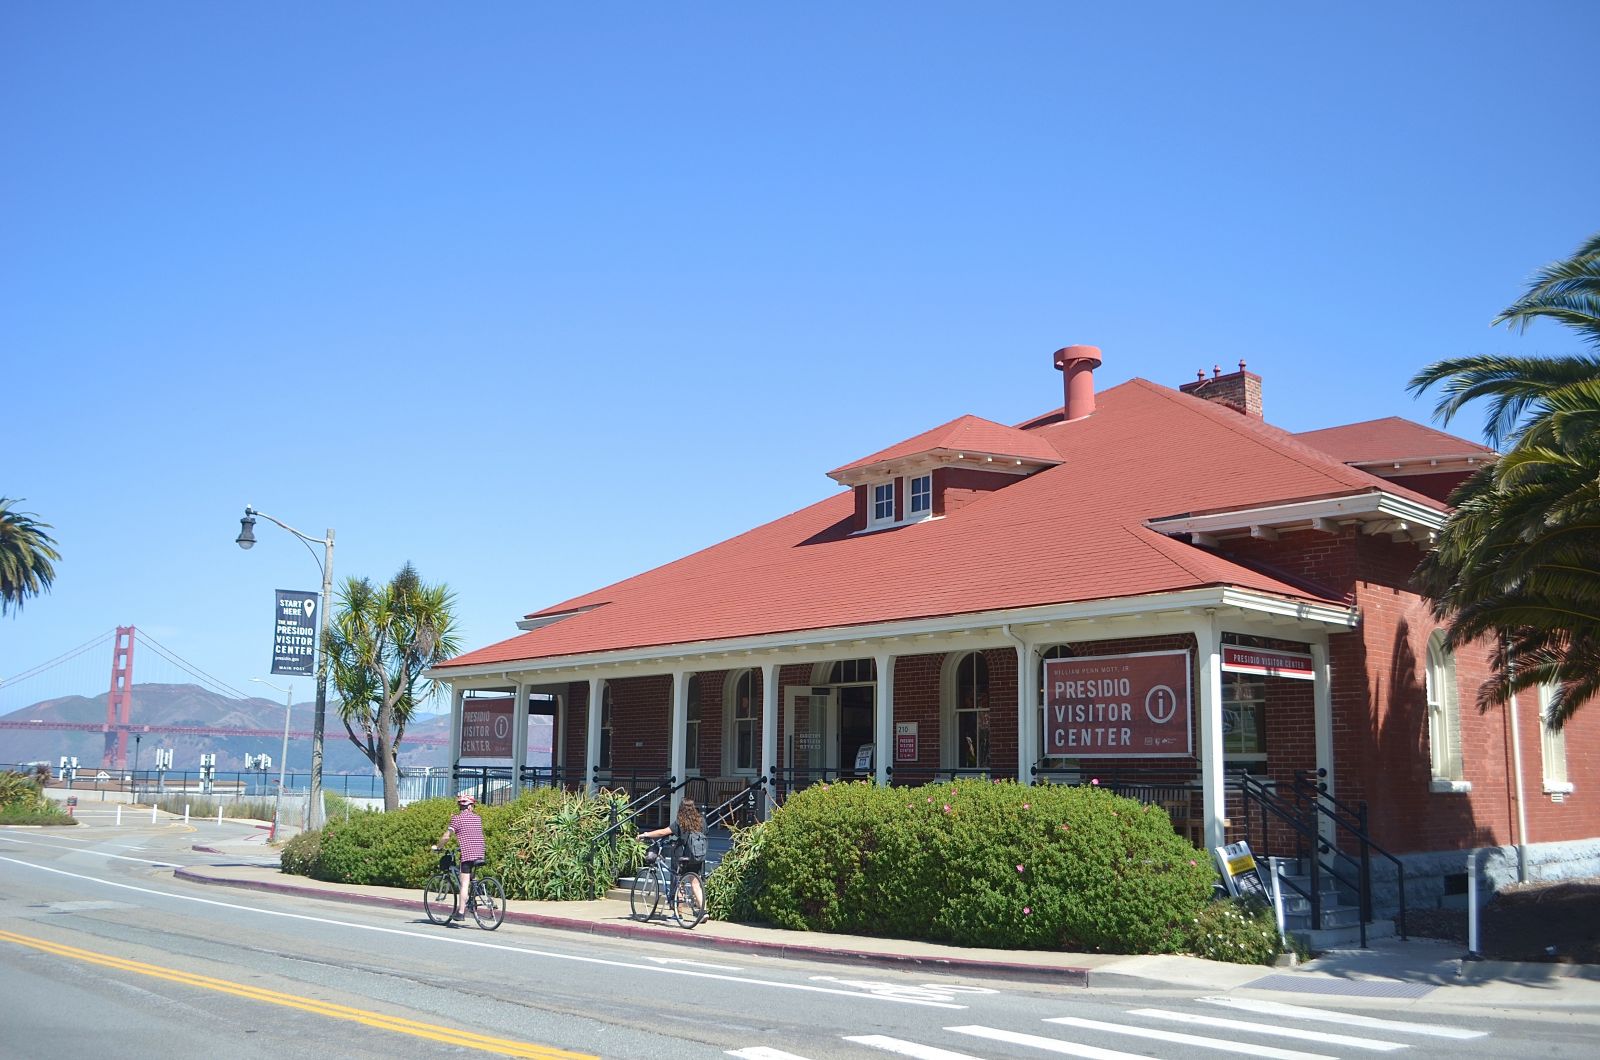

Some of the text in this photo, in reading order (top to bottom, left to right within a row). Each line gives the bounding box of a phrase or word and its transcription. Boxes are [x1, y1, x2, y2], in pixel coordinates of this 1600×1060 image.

[280, 599, 302, 607] START
[283, 607, 302, 616] HERE
[277, 626, 313, 635] PRESIDIO
[276, 635, 313, 646] VISITOR
[275, 645, 312, 655] CENTER
[1233, 654, 1304, 668] PRESIDIO VISITOR CENTER
[1054, 668, 1080, 677] WILLIAM
[1055, 678, 1130, 699] PRESIDIO
[464, 711, 489, 722] PRESIDIO
[1055, 703, 1132, 723] VISITOR
[1055, 728, 1131, 747] CENTER
[463, 741, 490, 751] CENTER
